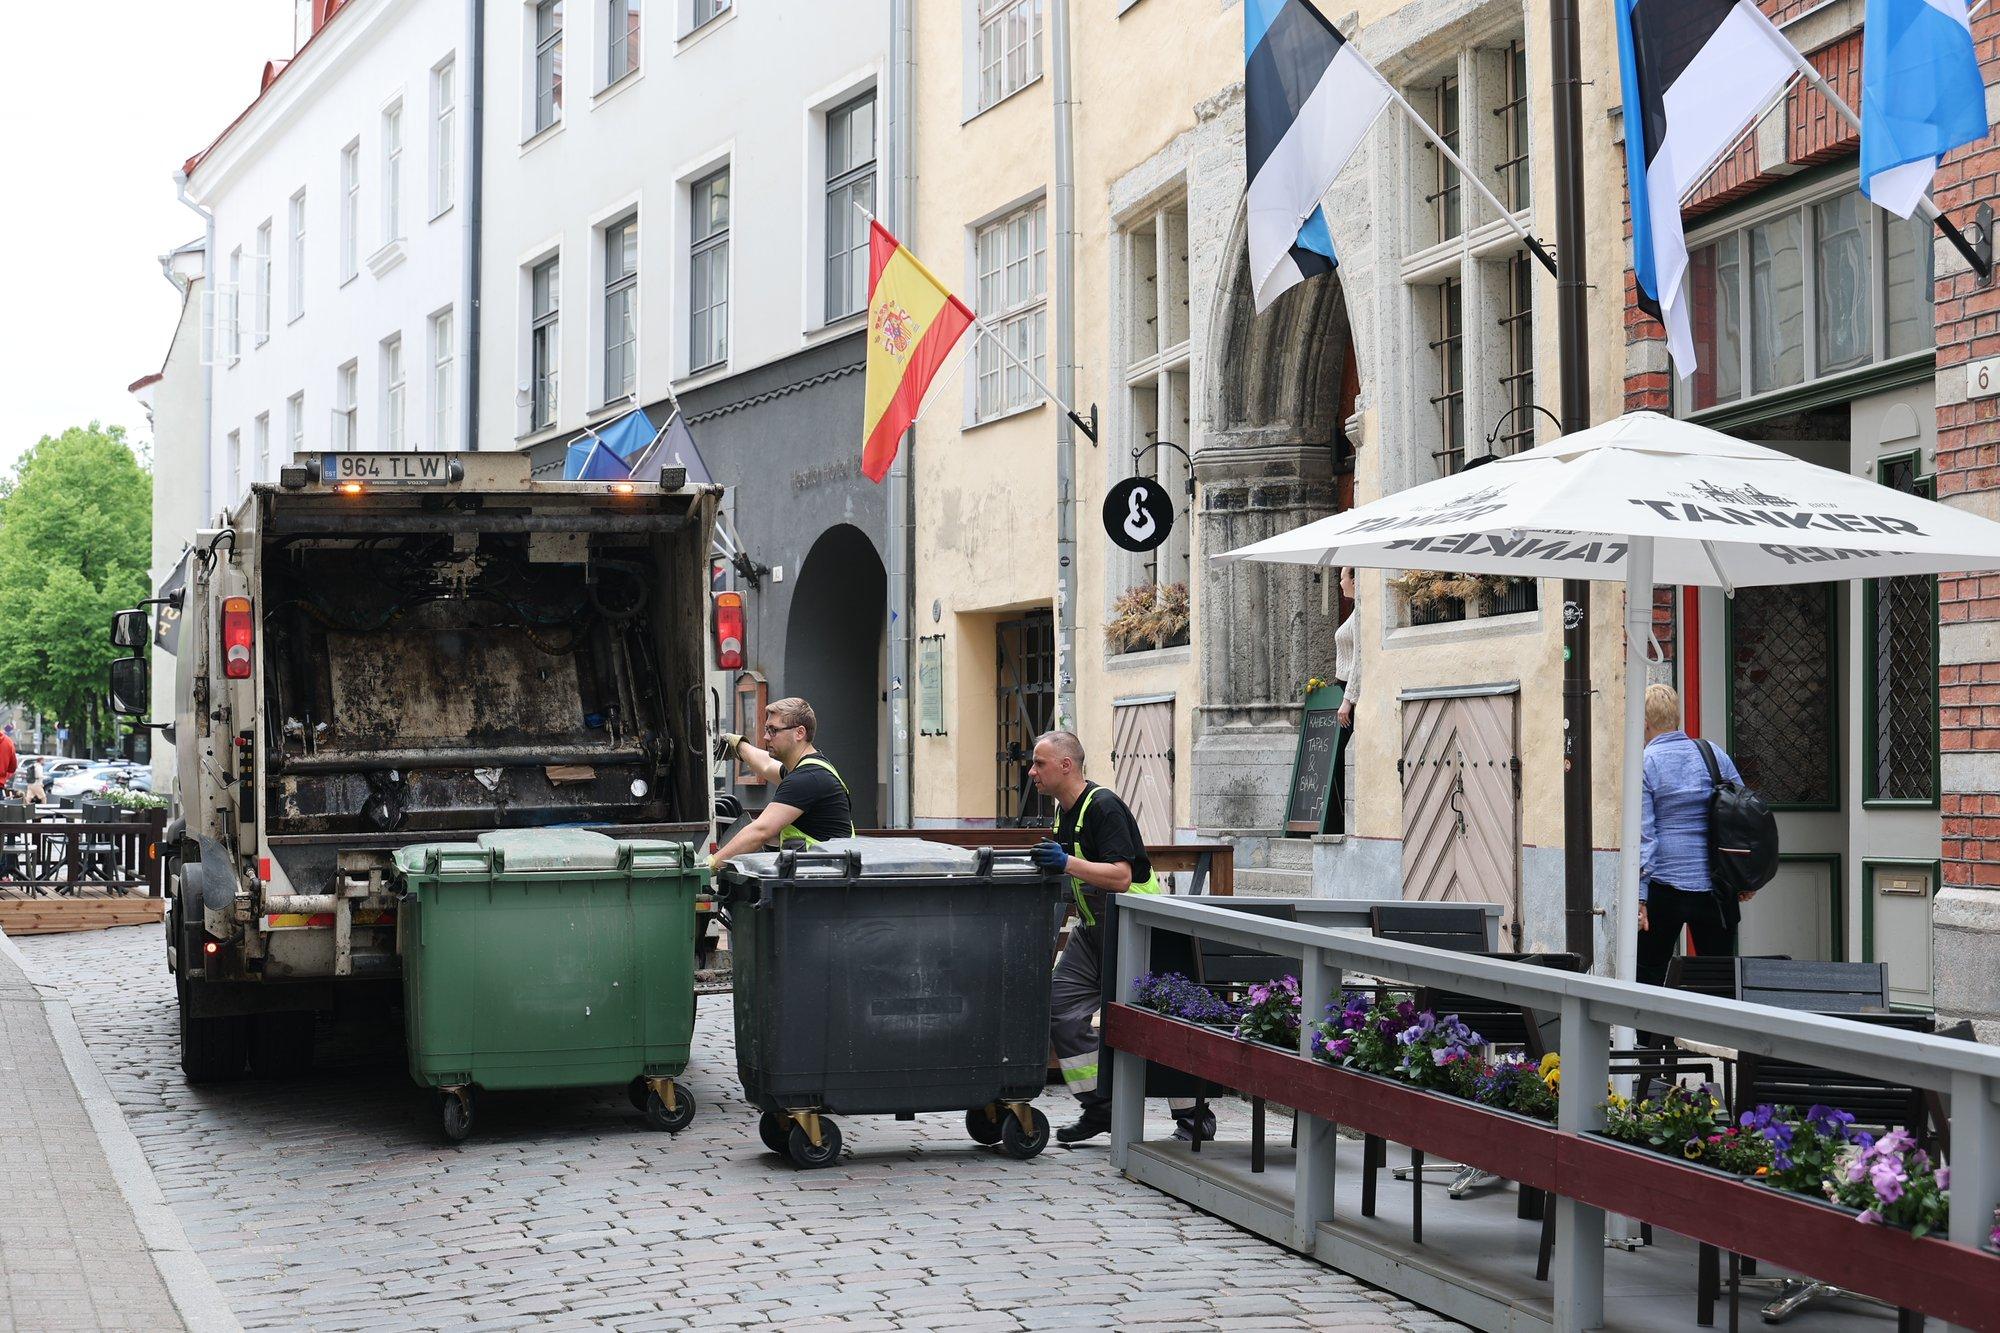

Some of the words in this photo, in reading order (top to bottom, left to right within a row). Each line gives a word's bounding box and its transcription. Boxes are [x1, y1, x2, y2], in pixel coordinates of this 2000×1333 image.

[1978, 365, 1989, 390] 6
[341, 457, 380, 477] 964
[389, 457, 440, 477] TLW
[1628, 499, 1932, 537] TANKER
[1307, 737, 1329, 752] TAPAS
[1308, 754, 1315, 772] &
